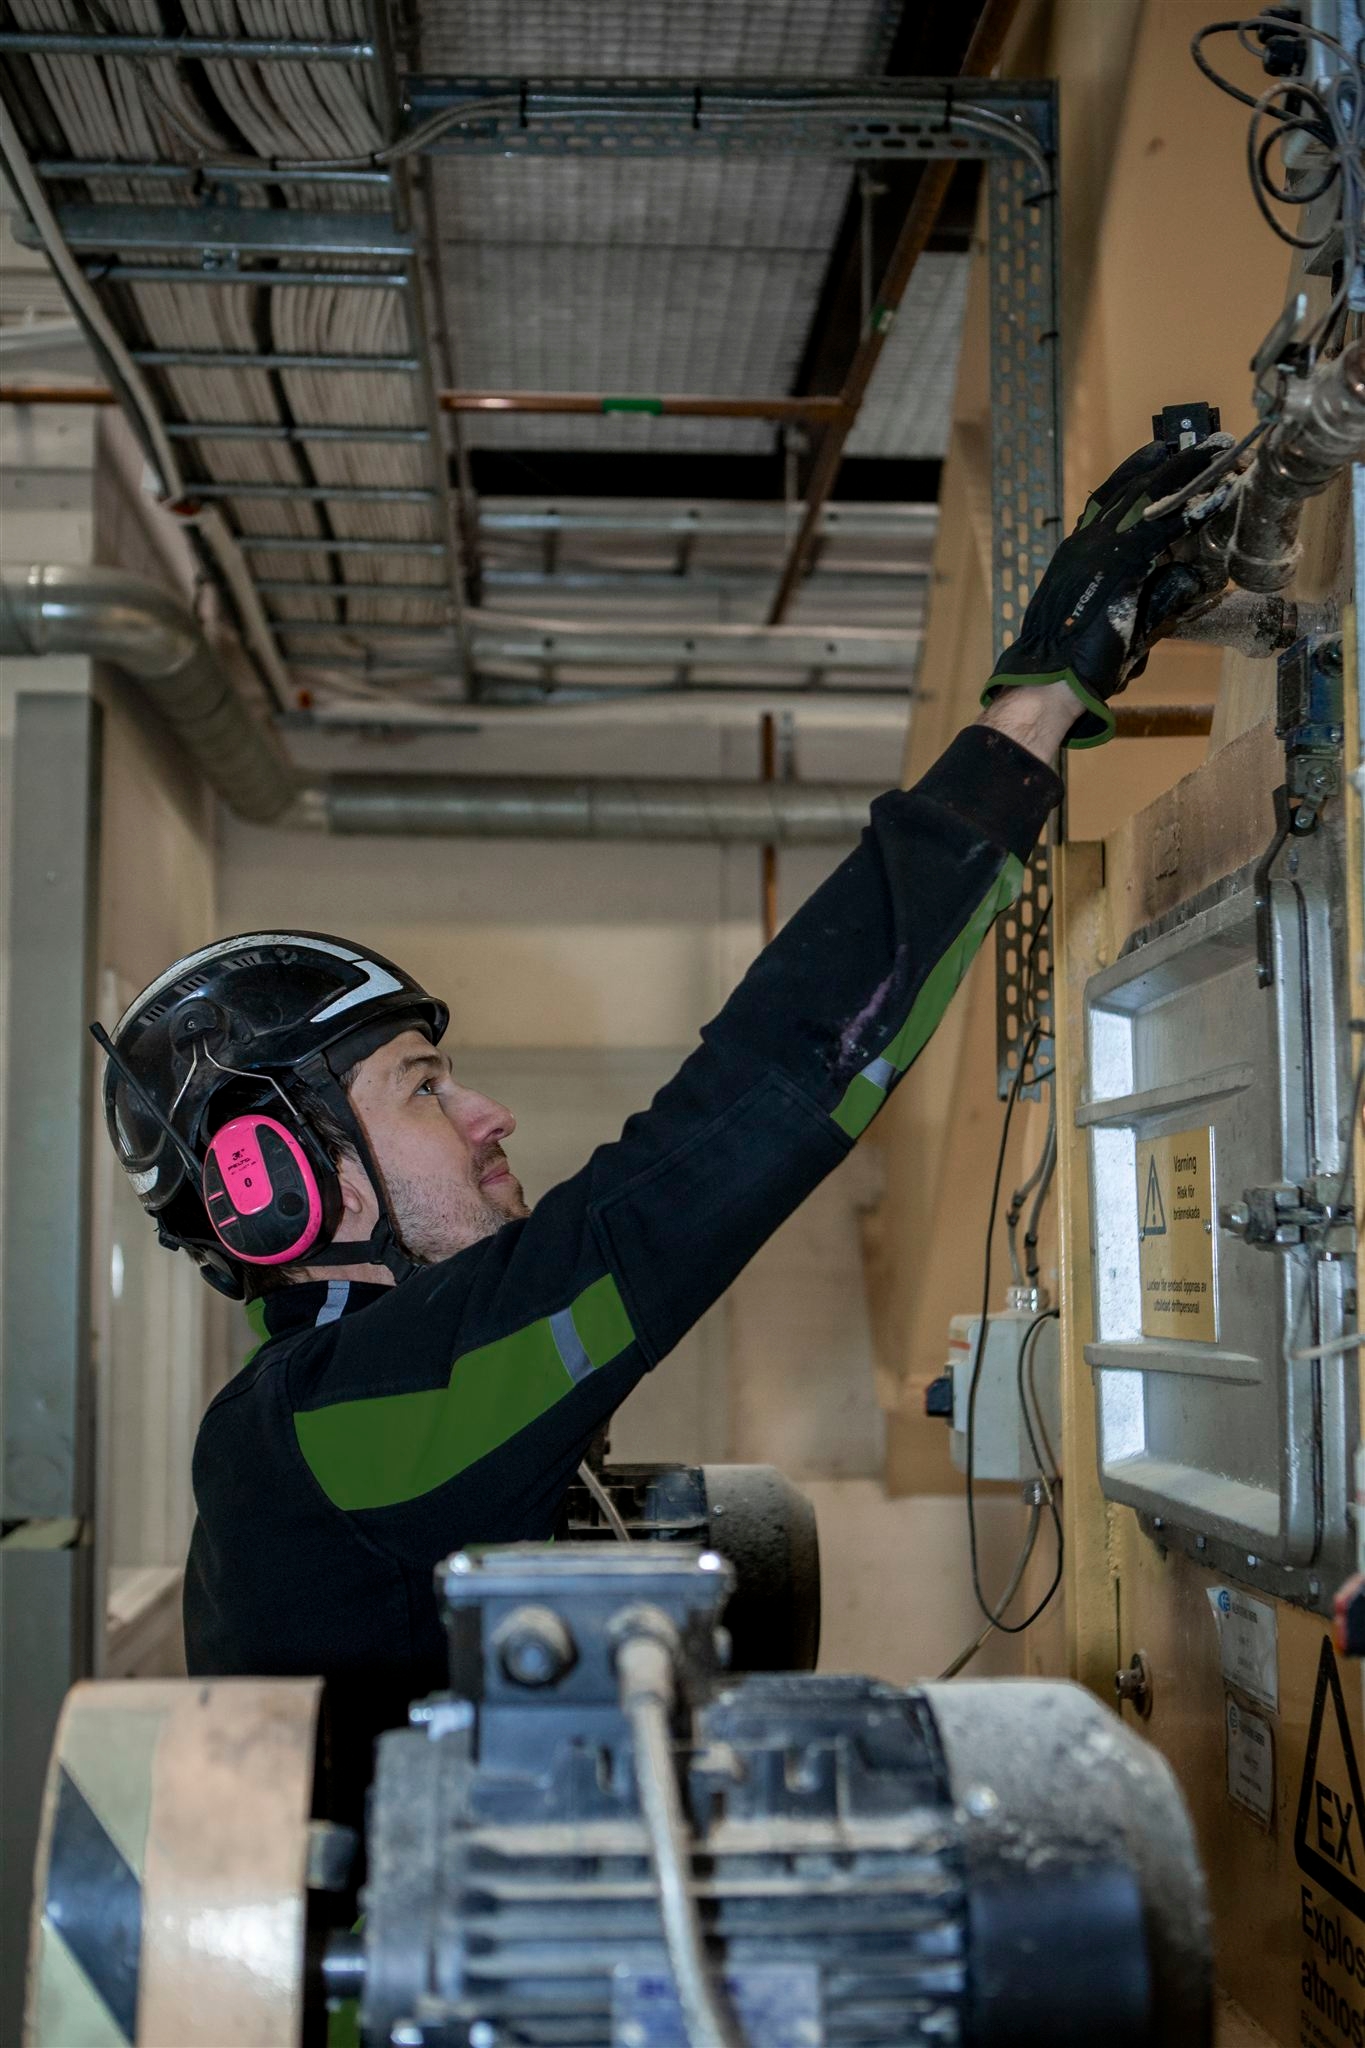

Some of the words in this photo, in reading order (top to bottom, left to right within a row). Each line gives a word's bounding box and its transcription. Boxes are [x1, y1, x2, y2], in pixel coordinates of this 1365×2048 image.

[1071, 575, 1104, 617] TEGERA
[1173, 1153, 1197, 1175] Varning
[1176, 1185, 1188, 1199] Risk
[1173, 1205, 1200, 1220] brännskada
[1316, 1780, 1357, 1877] EX
[1301, 1961, 1365, 2048] atmos
